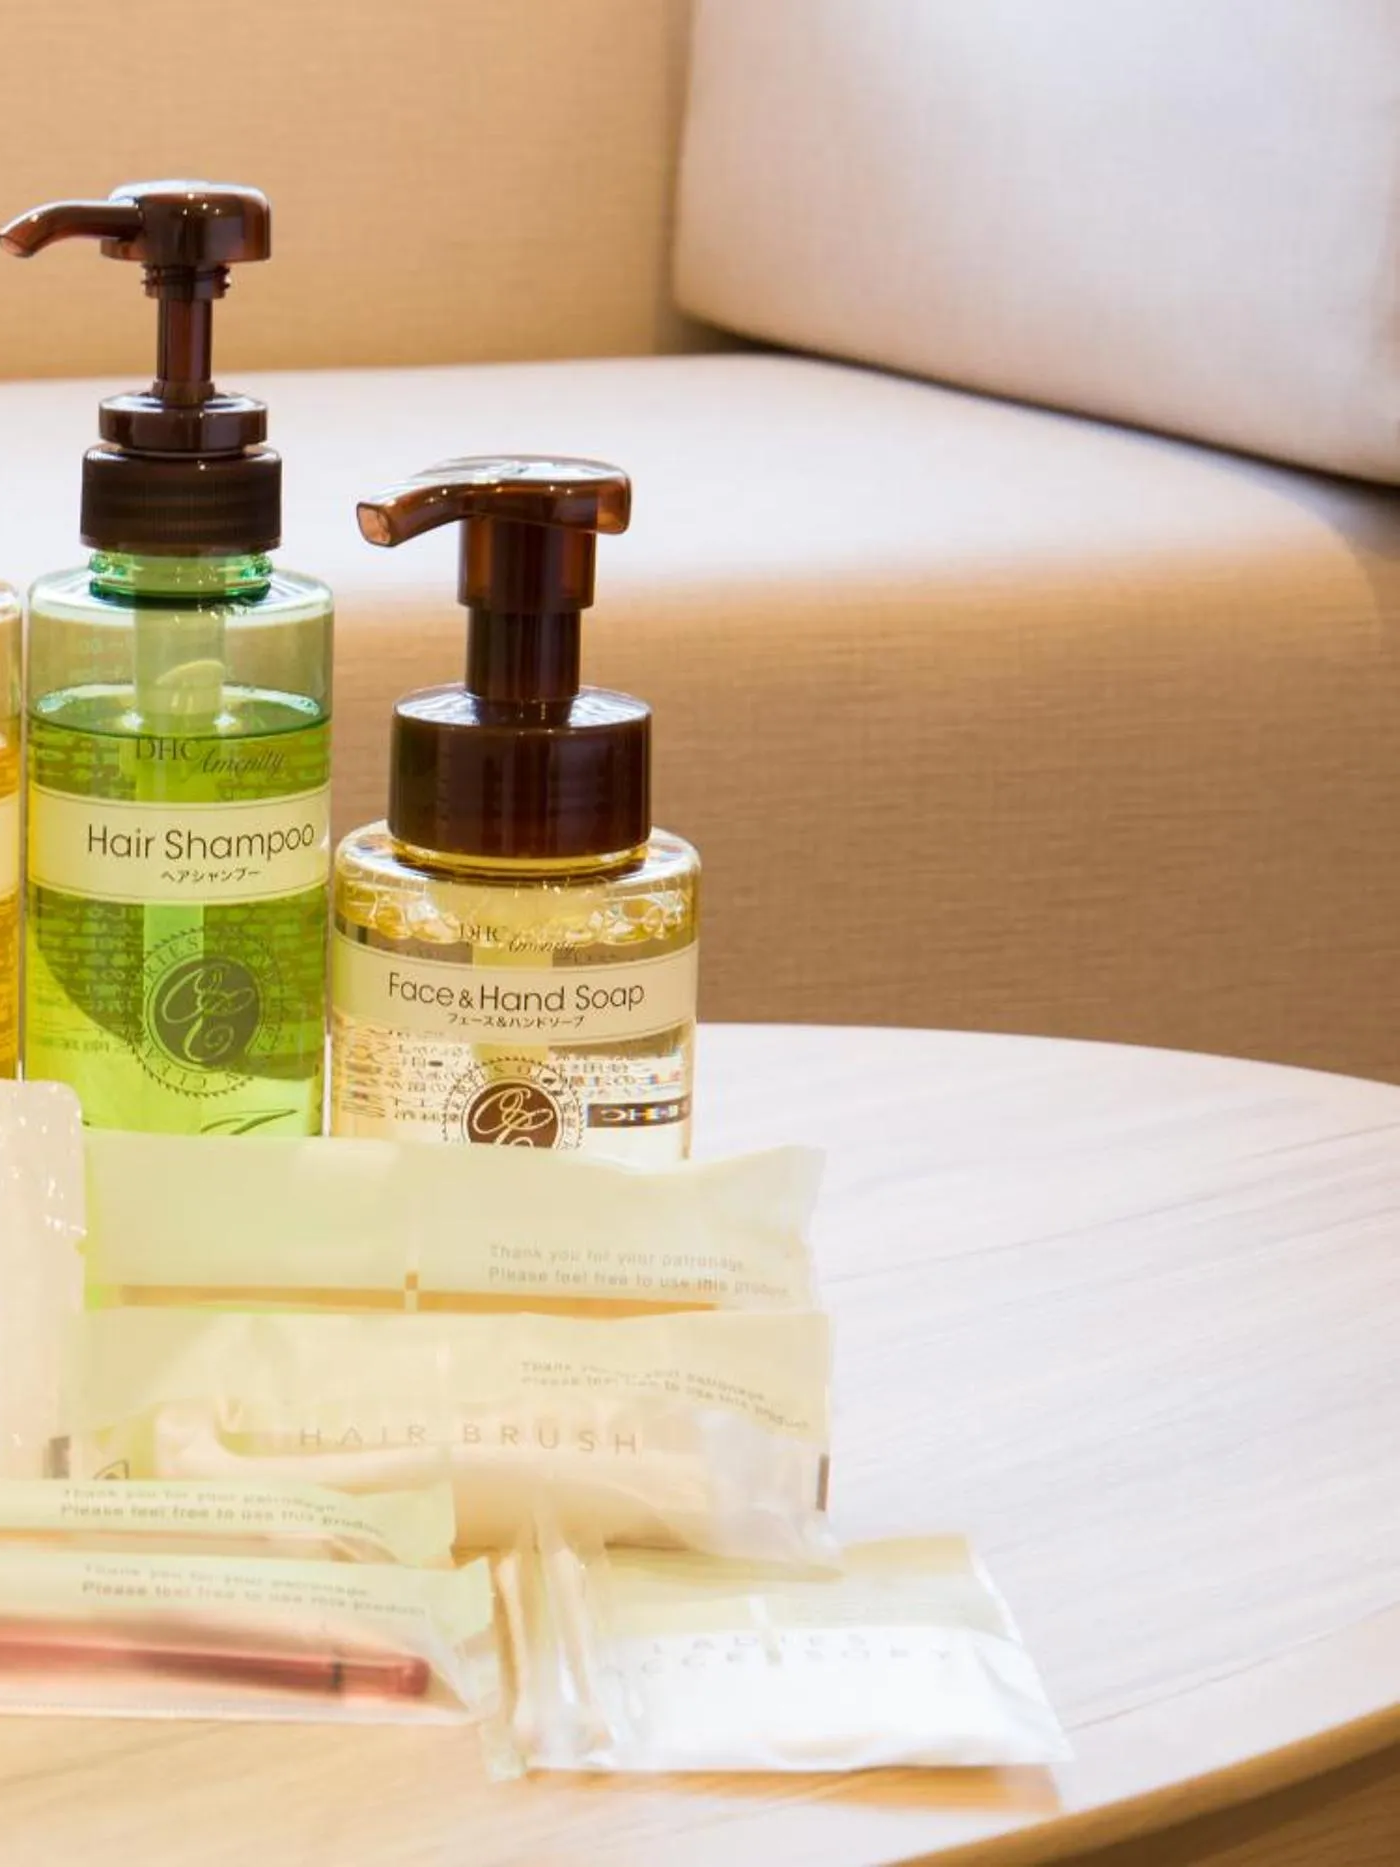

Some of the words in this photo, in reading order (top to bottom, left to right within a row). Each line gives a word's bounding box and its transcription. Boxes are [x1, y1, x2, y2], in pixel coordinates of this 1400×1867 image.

[136, 737, 198, 761] DHC
[88, 824, 156, 860] Hair
[165, 822, 316, 862] Shampoo
[576, 984, 645, 1012] Soap
[489, 1244, 542, 1260] Thank
[488, 1266, 548, 1283] Please
[299, 1423, 428, 1449] HAIR
[462, 1421, 638, 1456] BRUSH
